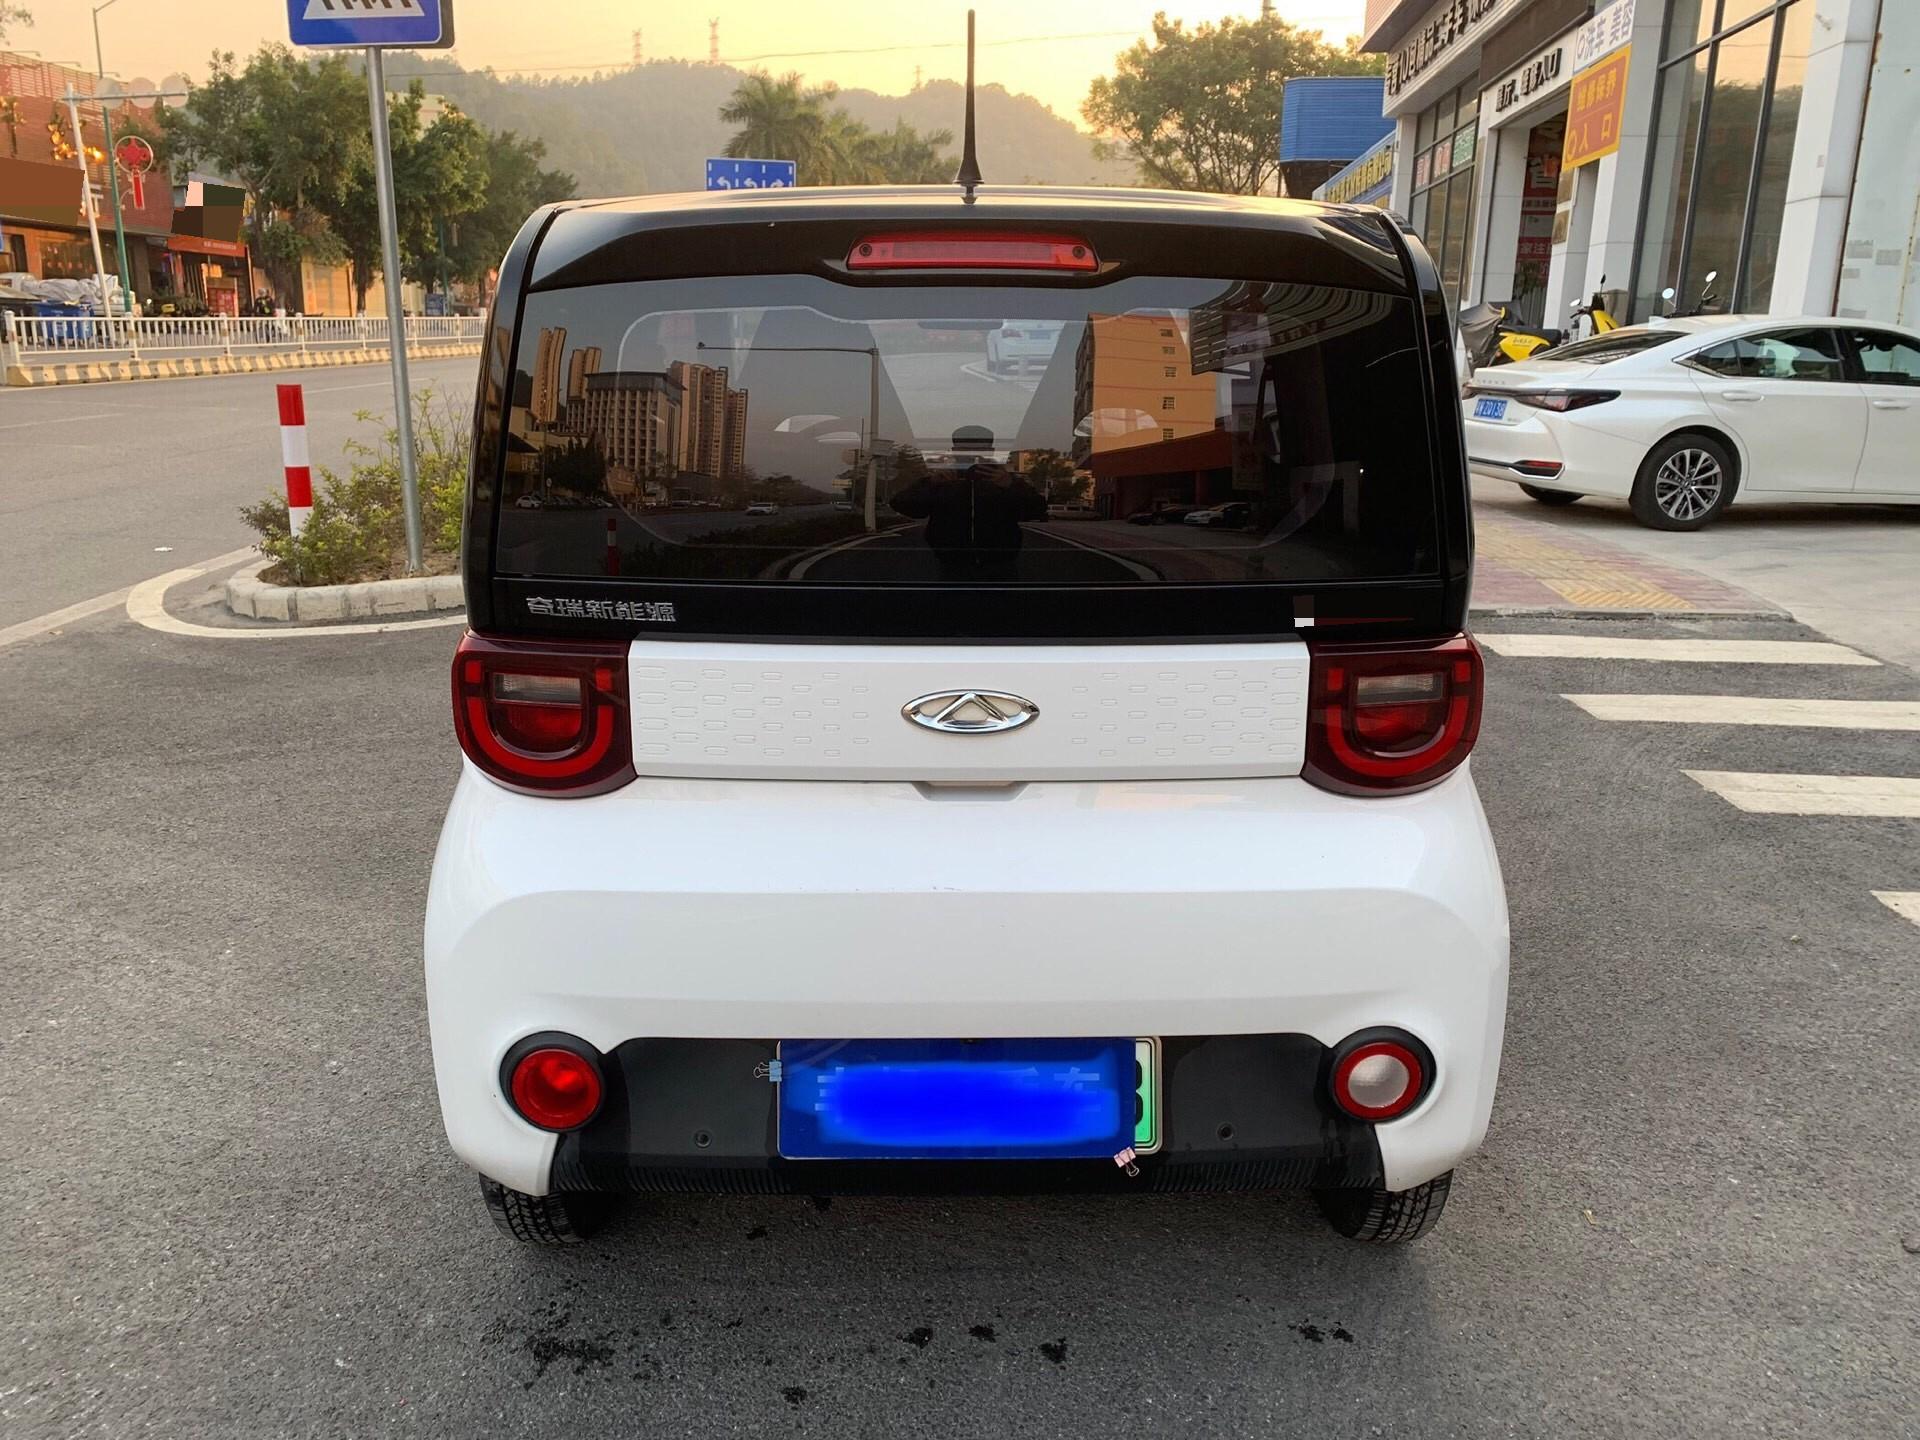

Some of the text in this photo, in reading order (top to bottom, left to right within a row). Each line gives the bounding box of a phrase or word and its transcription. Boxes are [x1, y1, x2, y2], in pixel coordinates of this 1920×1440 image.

[526, 597, 676, 622] 奇瑞新能源
